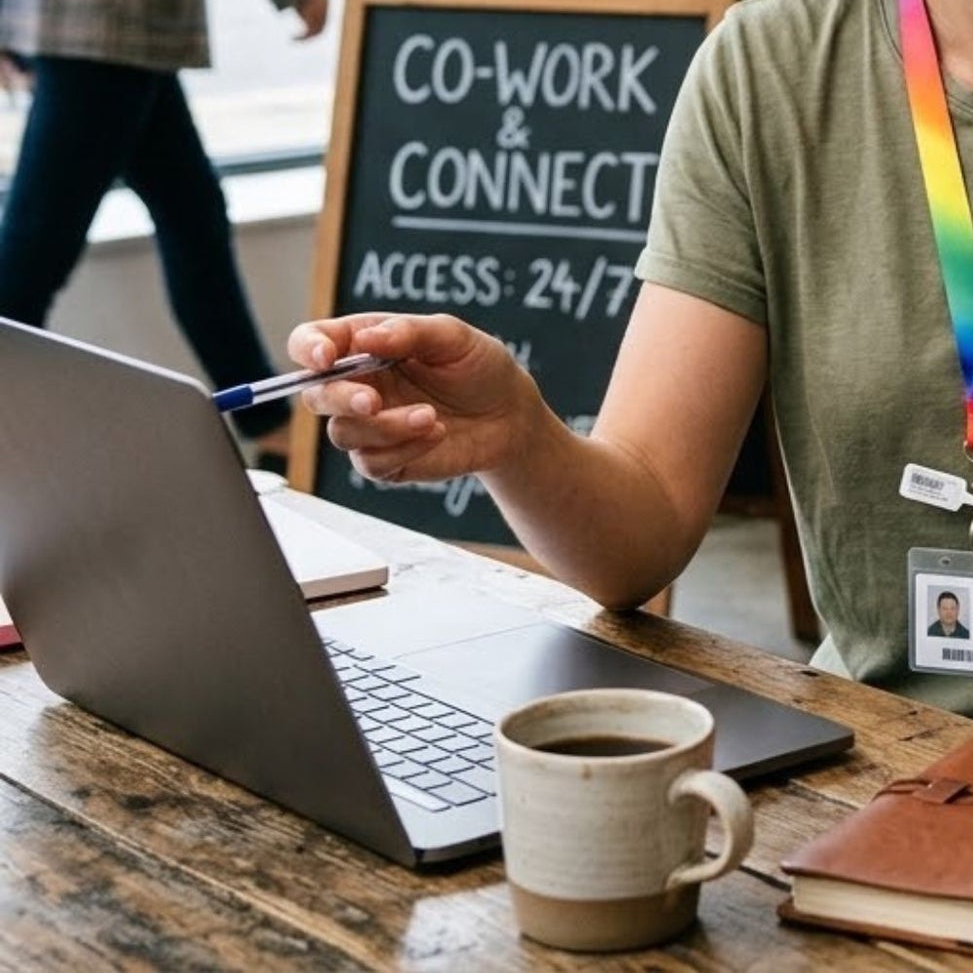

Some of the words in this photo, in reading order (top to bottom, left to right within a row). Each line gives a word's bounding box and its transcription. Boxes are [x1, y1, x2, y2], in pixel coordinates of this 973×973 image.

[392, 34, 659, 114] CO-WORK
[496, 105, 532, 149] &
[389, 141, 659, 223] CONNECT
[353, 250, 516, 307] ACCESS:
[523, 255, 634, 320] 24/7
